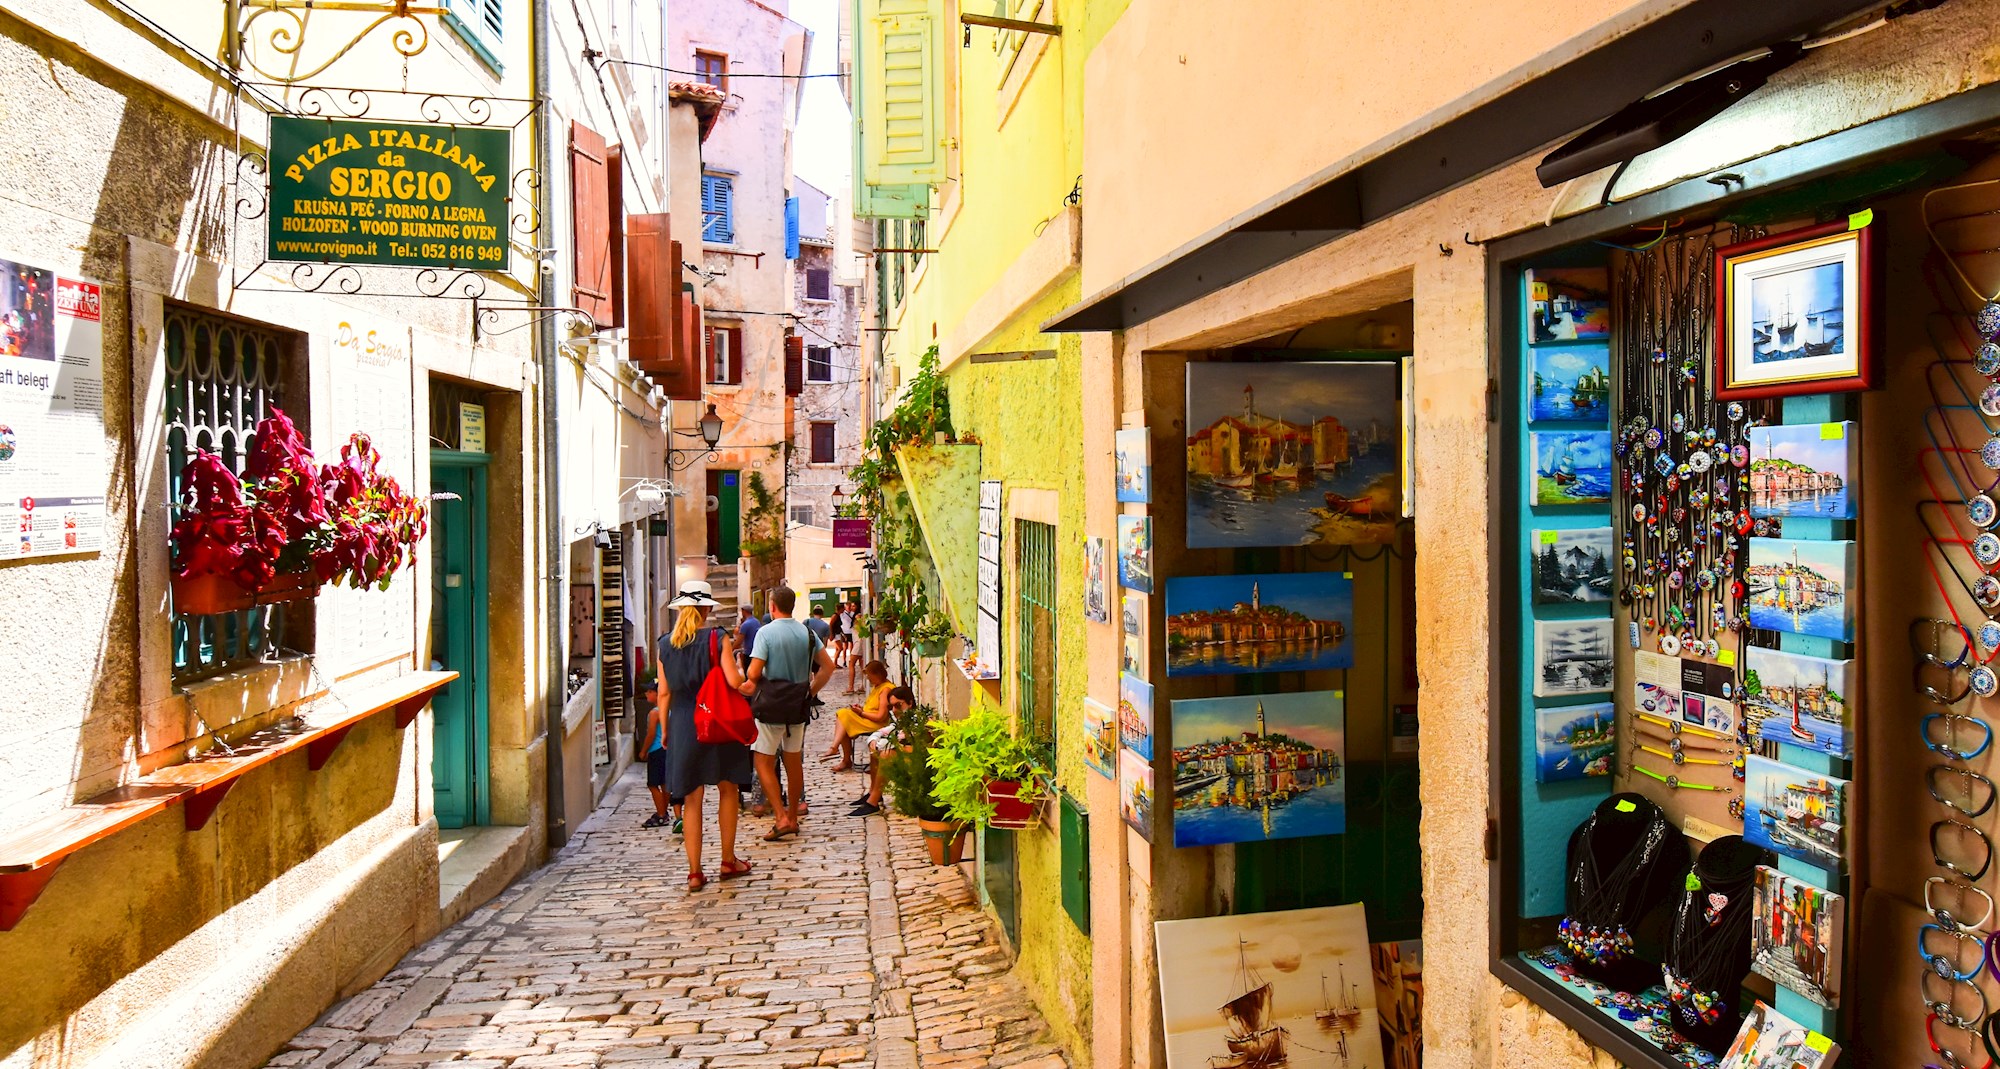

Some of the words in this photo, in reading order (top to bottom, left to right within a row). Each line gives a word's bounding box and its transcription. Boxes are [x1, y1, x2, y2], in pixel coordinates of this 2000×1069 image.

[284, 133, 363, 184] PIZZA
[368, 129, 497, 193] ITALIANA
[377, 150, 406, 168] da
[329, 166, 452, 202] SERGIO
[293, 197, 348, 216] KRUŠNA
[350, 199, 375, 218] PEĆ
[385, 203, 430, 221] FORNO
[431, 205, 442, 221] A
[443, 206, 487, 223] LEGNA
[282, 216, 350, 234] HOLZOFEN
[359, 219, 399, 236] WOOD
[400, 221, 460, 240] BURNING
[462, 224, 498, 241] OVEN
[276, 239, 378, 259] www.rovigno.it
[389, 241, 419, 258] Tel.:
[421, 243, 447, 259] 052
[449, 244, 475, 260] 816
[477, 245, 503, 262] 949
[57, 284, 99, 304] adria
[57, 297, 99, 314] ZEITUNG
[337, 321, 361, 351] Da
[365, 330, 403, 367] Sergio
[356, 352, 387, 369] pizzeria
[17, 370, 49, 391] belegt
